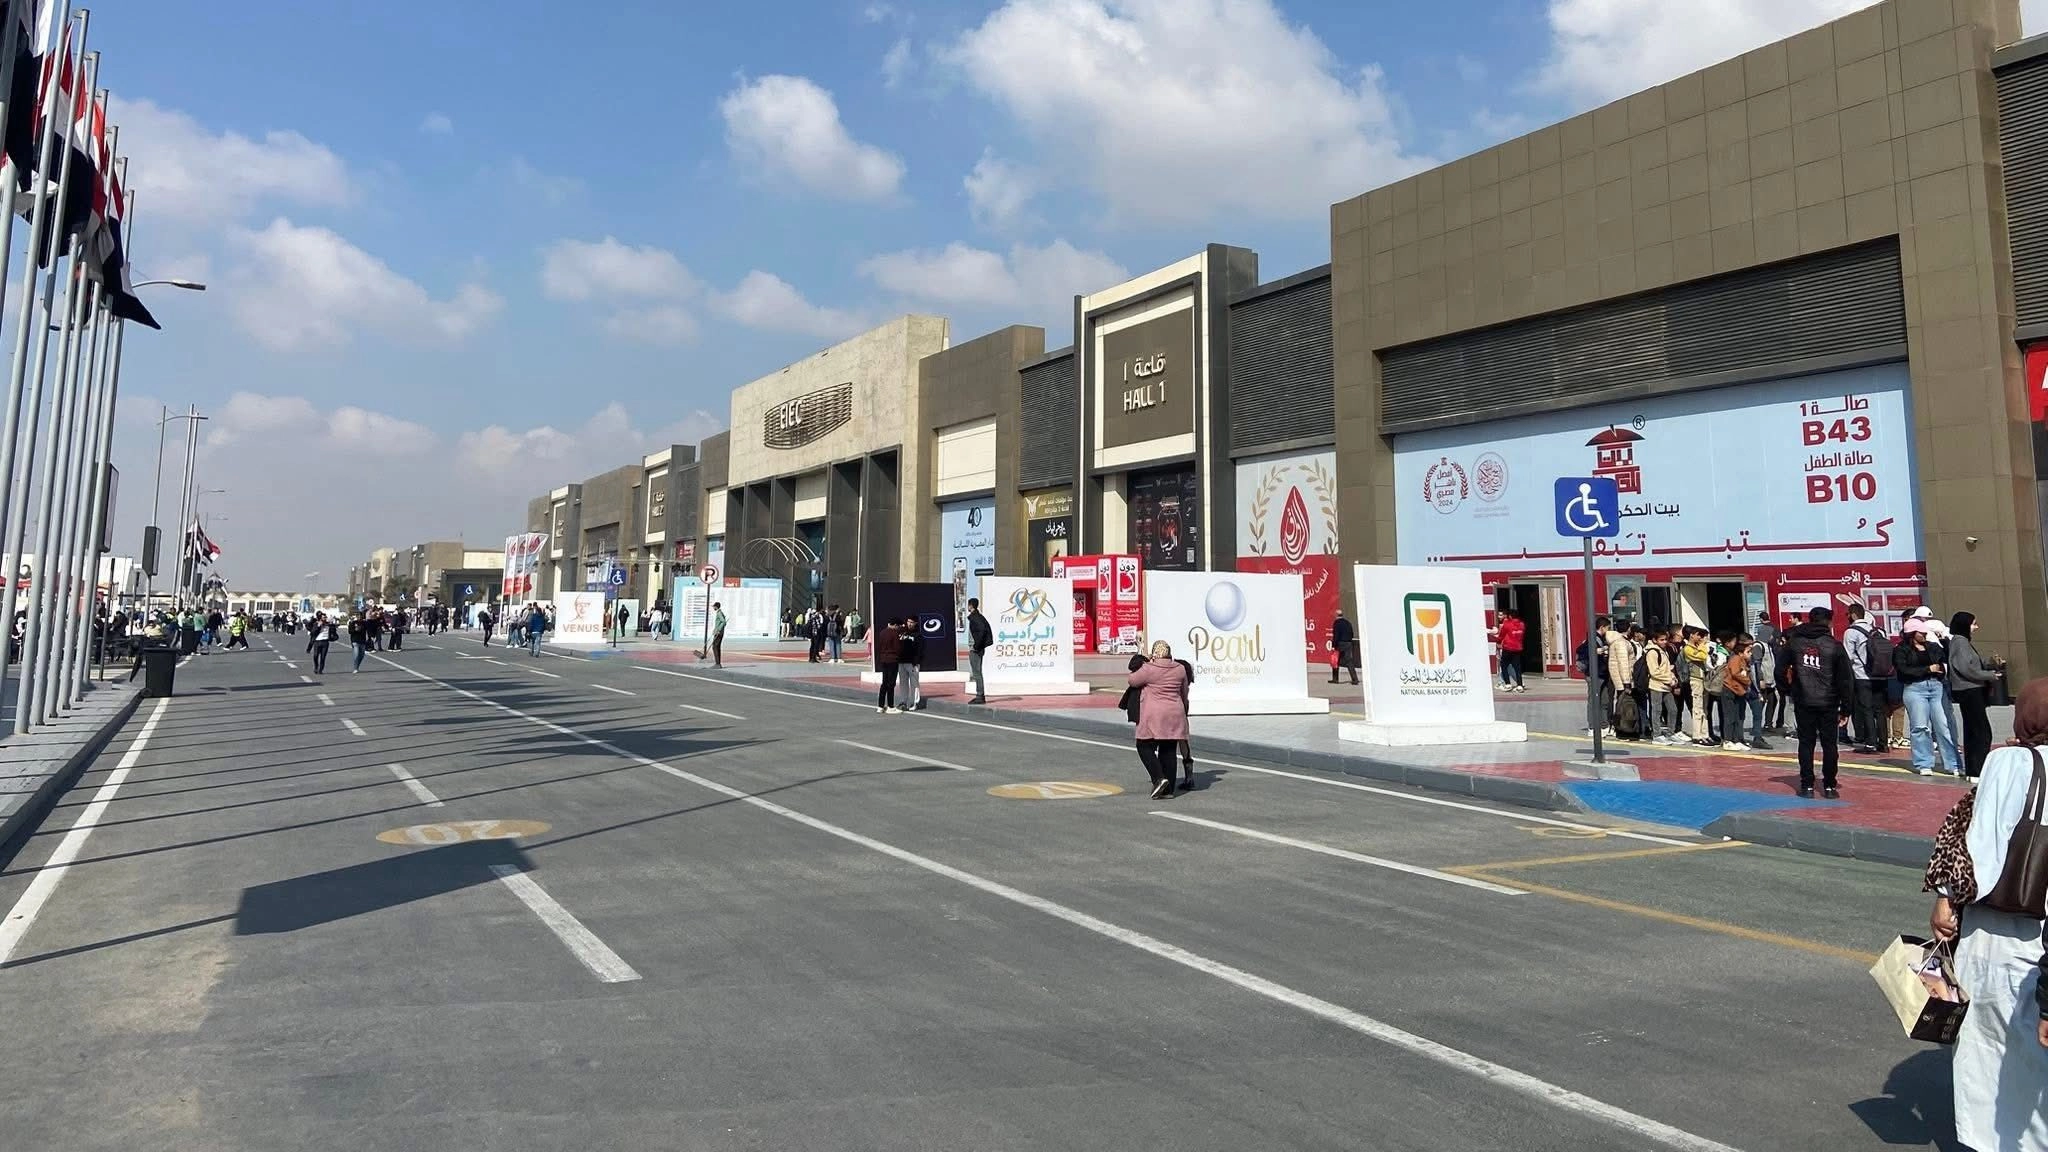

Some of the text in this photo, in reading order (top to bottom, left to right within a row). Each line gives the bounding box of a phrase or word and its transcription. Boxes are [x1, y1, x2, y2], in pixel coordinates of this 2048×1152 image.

[1134, 353, 1166, 376] قاعة
[1124, 380, 1165, 411] HALL 1
[1800, 394, 1868, 416] صالة 1
[780, 400, 802, 430] EIEC
[1802, 416, 1872, 446] B43
[1805, 450, 1872, 471] صالة الطفل
[1806, 472, 1876, 503] B10
[1618, 503, 1680, 518] بيت الحكم
[1863, 574, 1927, 586] جمع
[563, 624, 600, 632] VENUS
[1000, 615, 1014, 623] fm
[998, 626, 1055, 643] الراديو
[1188, 624, 1266, 661] Pearl
[996, 644, 1058, 657] 90.90 FM
[1196, 666, 1221, 675] Dental
[1234, 665, 1261, 676] Beauty
[1401, 688, 1426, 696] NATIONAL
[1427, 688, 1442, 696] BANK
[1451, 688, 1467, 696] EGYPT
